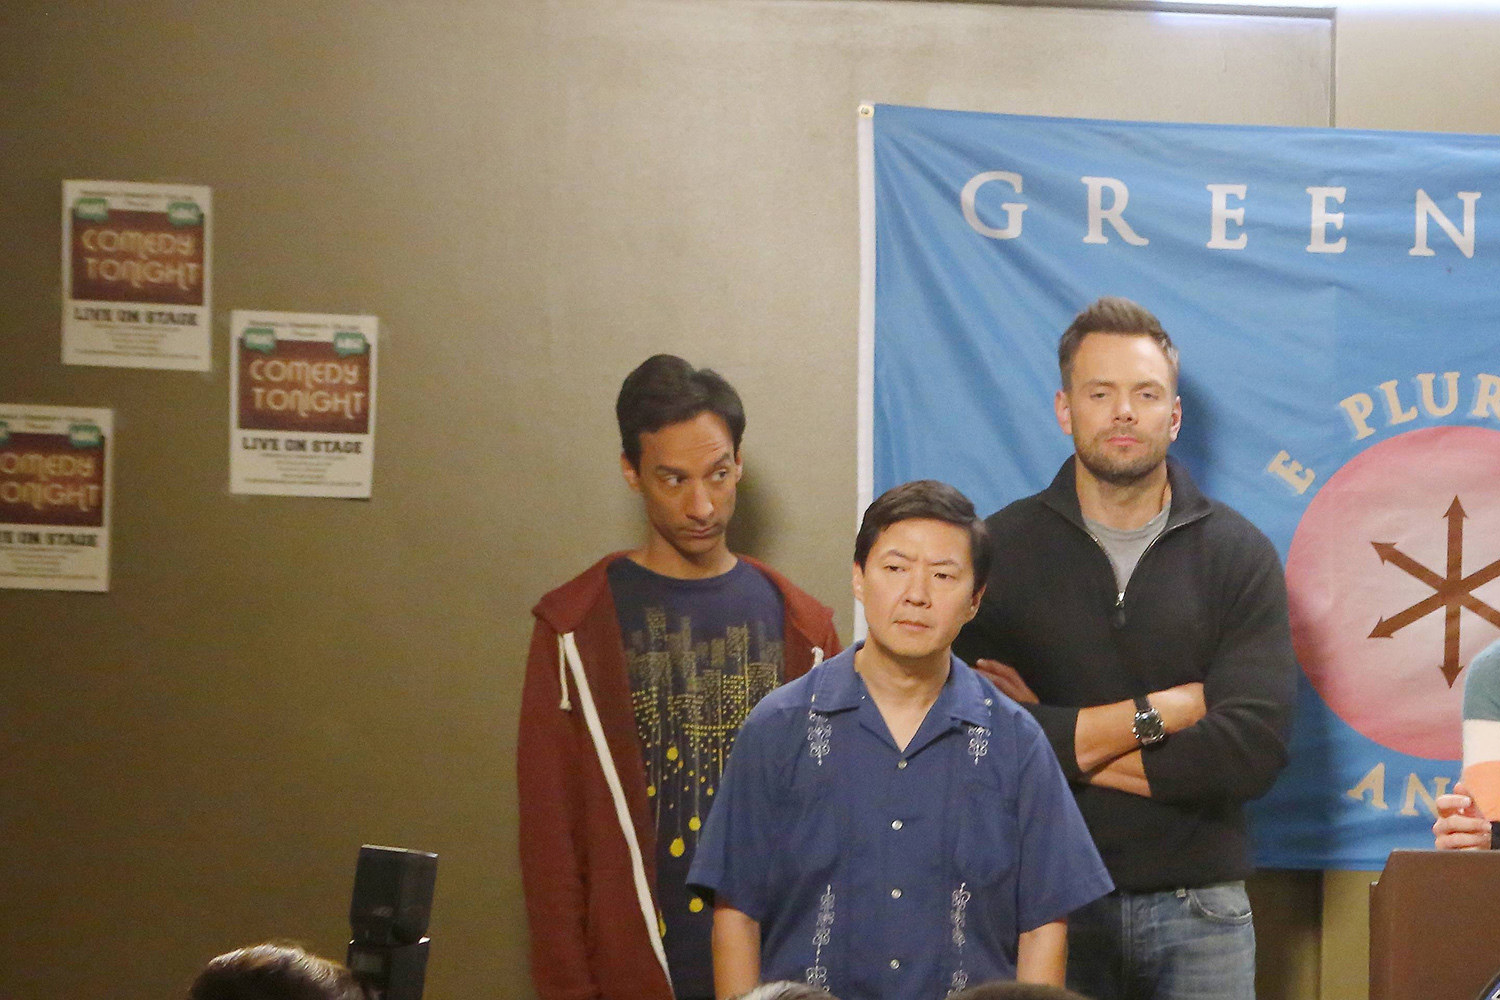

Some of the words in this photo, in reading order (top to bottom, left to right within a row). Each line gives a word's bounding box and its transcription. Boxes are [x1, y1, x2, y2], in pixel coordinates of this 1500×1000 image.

[82, 228, 195, 260] COMEDY
[249, 358, 359, 389] COMEDY
[251, 386, 365, 420] TONIGHT
[242, 436, 279, 451] LIVE
[285, 438, 307, 451] ON
[312, 440, 362, 454] STAGE
[1268, 450, 1316, 495] E
